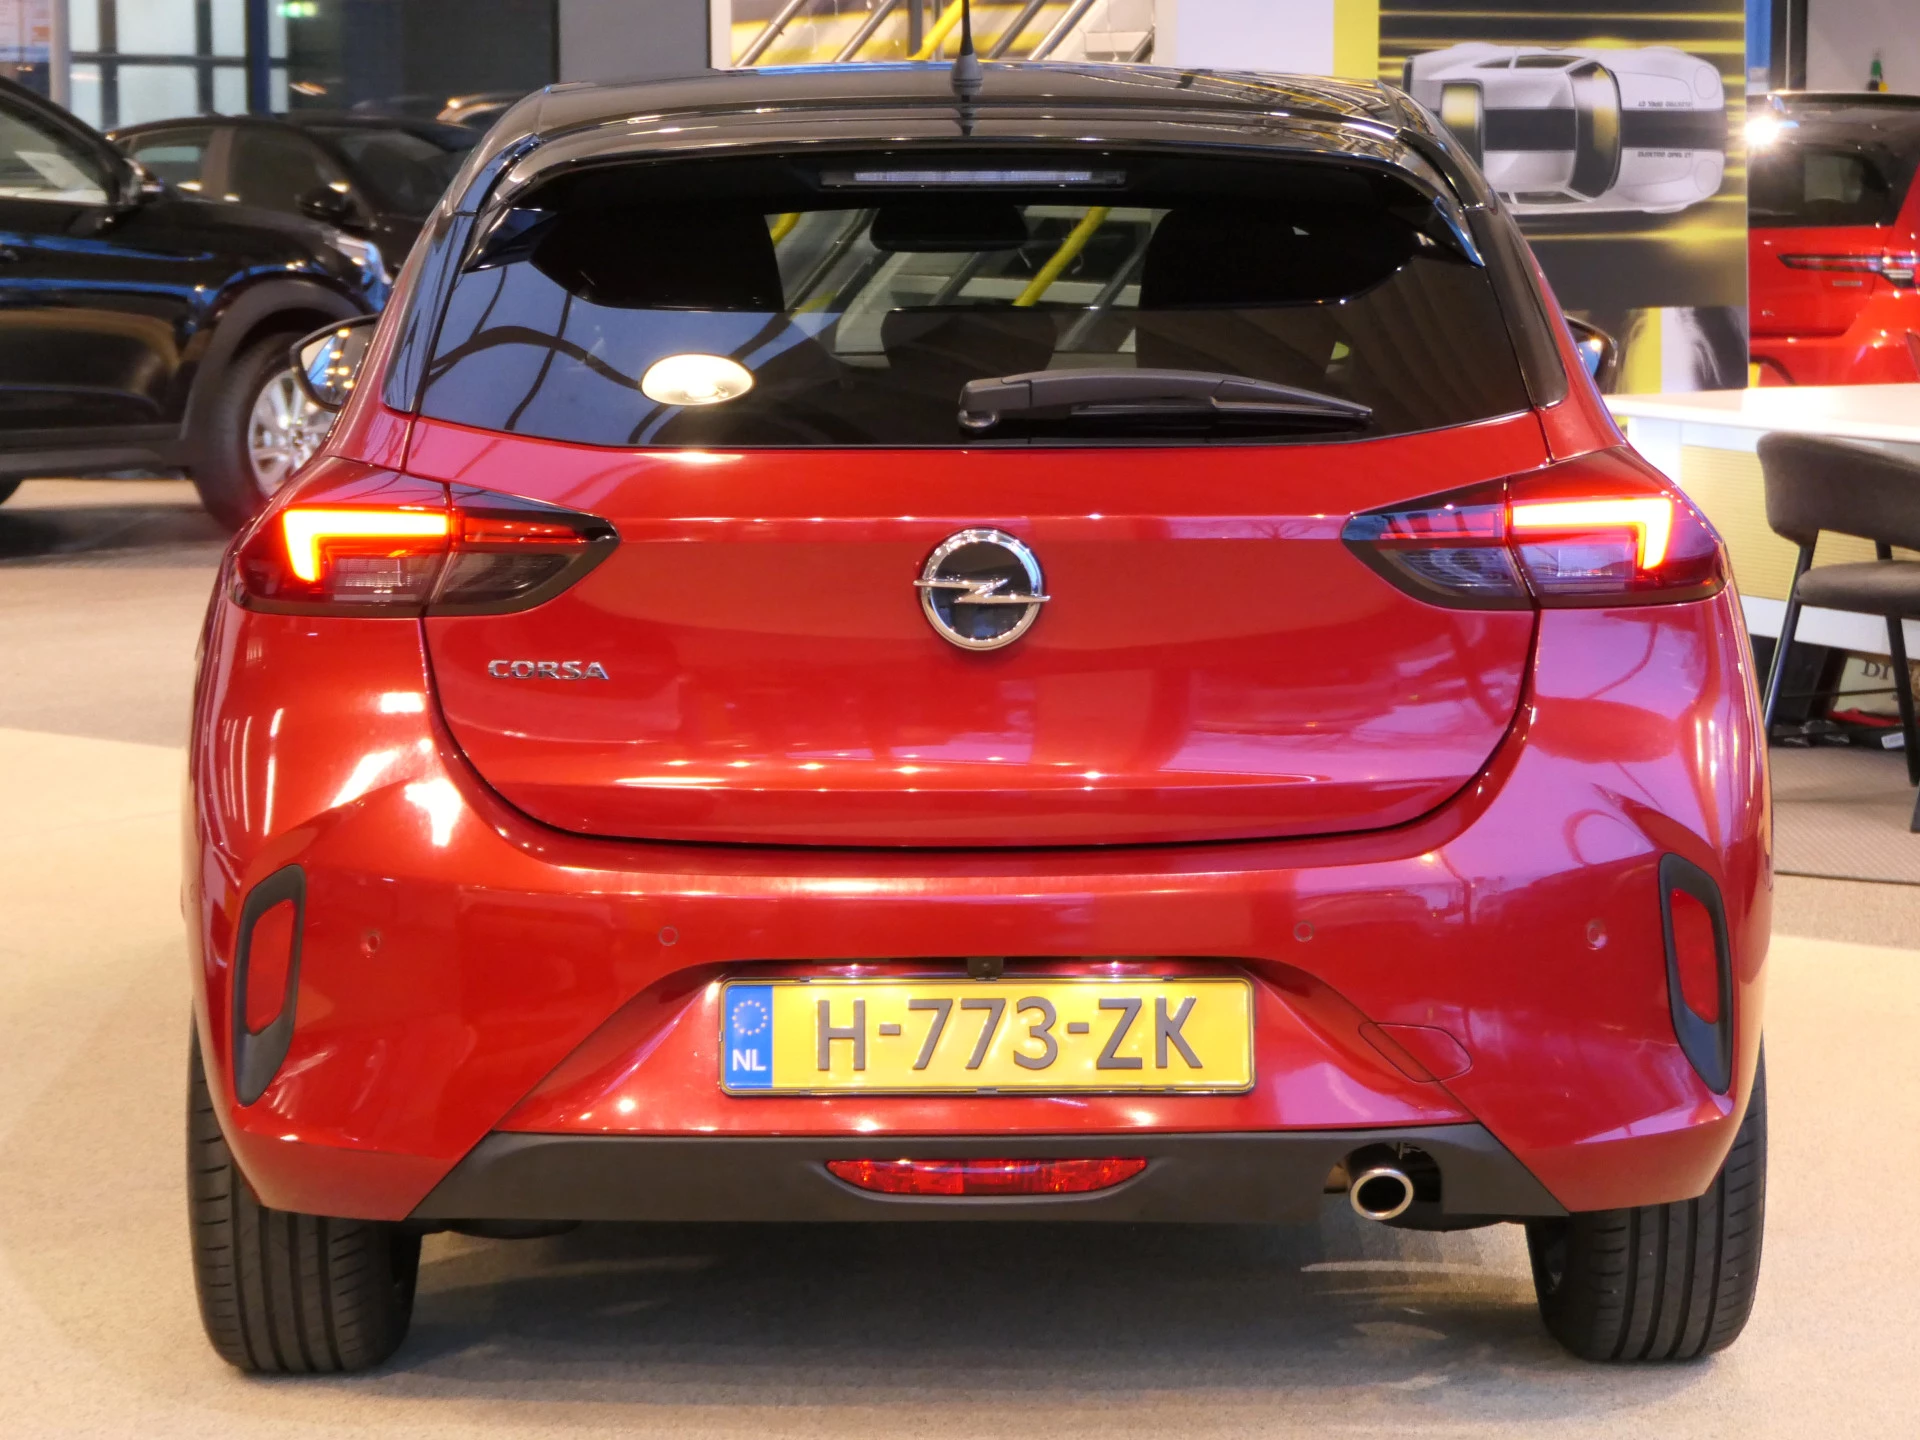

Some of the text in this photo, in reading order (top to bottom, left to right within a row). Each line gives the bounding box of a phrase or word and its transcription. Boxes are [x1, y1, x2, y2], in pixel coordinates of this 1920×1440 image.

[488, 660, 609, 680] CORSA
[817, 996, 1203, 1071] H-773-ZK
[732, 1049, 766, 1071] NL
